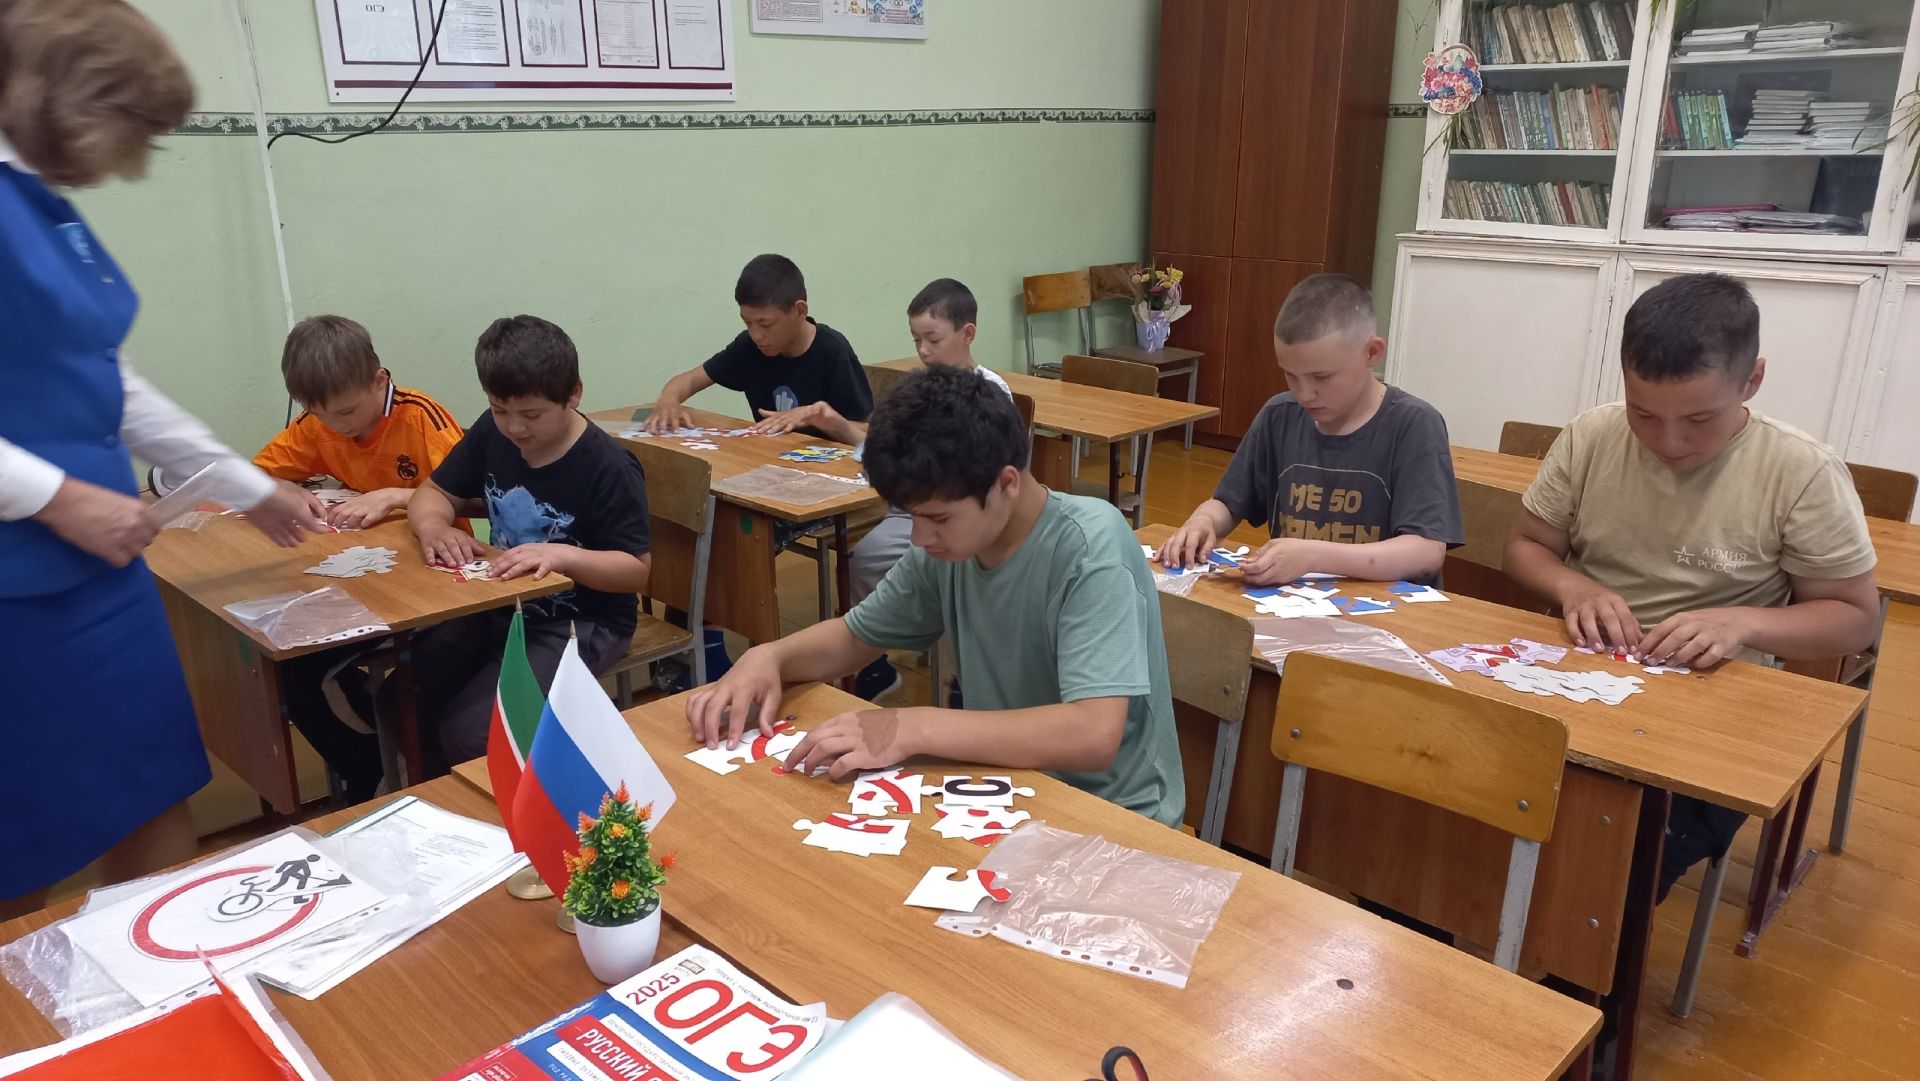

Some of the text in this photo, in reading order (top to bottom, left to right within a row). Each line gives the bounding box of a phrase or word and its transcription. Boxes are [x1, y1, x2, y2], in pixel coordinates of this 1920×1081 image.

[1290, 483, 1323, 512] ME
[1702, 547, 1747, 562] АРМИЯ
[625, 972, 681, 1006] 2025
[653, 979, 808, 1074] ОГЭ
[575, 1027, 652, 1081] РУССКИЙ
